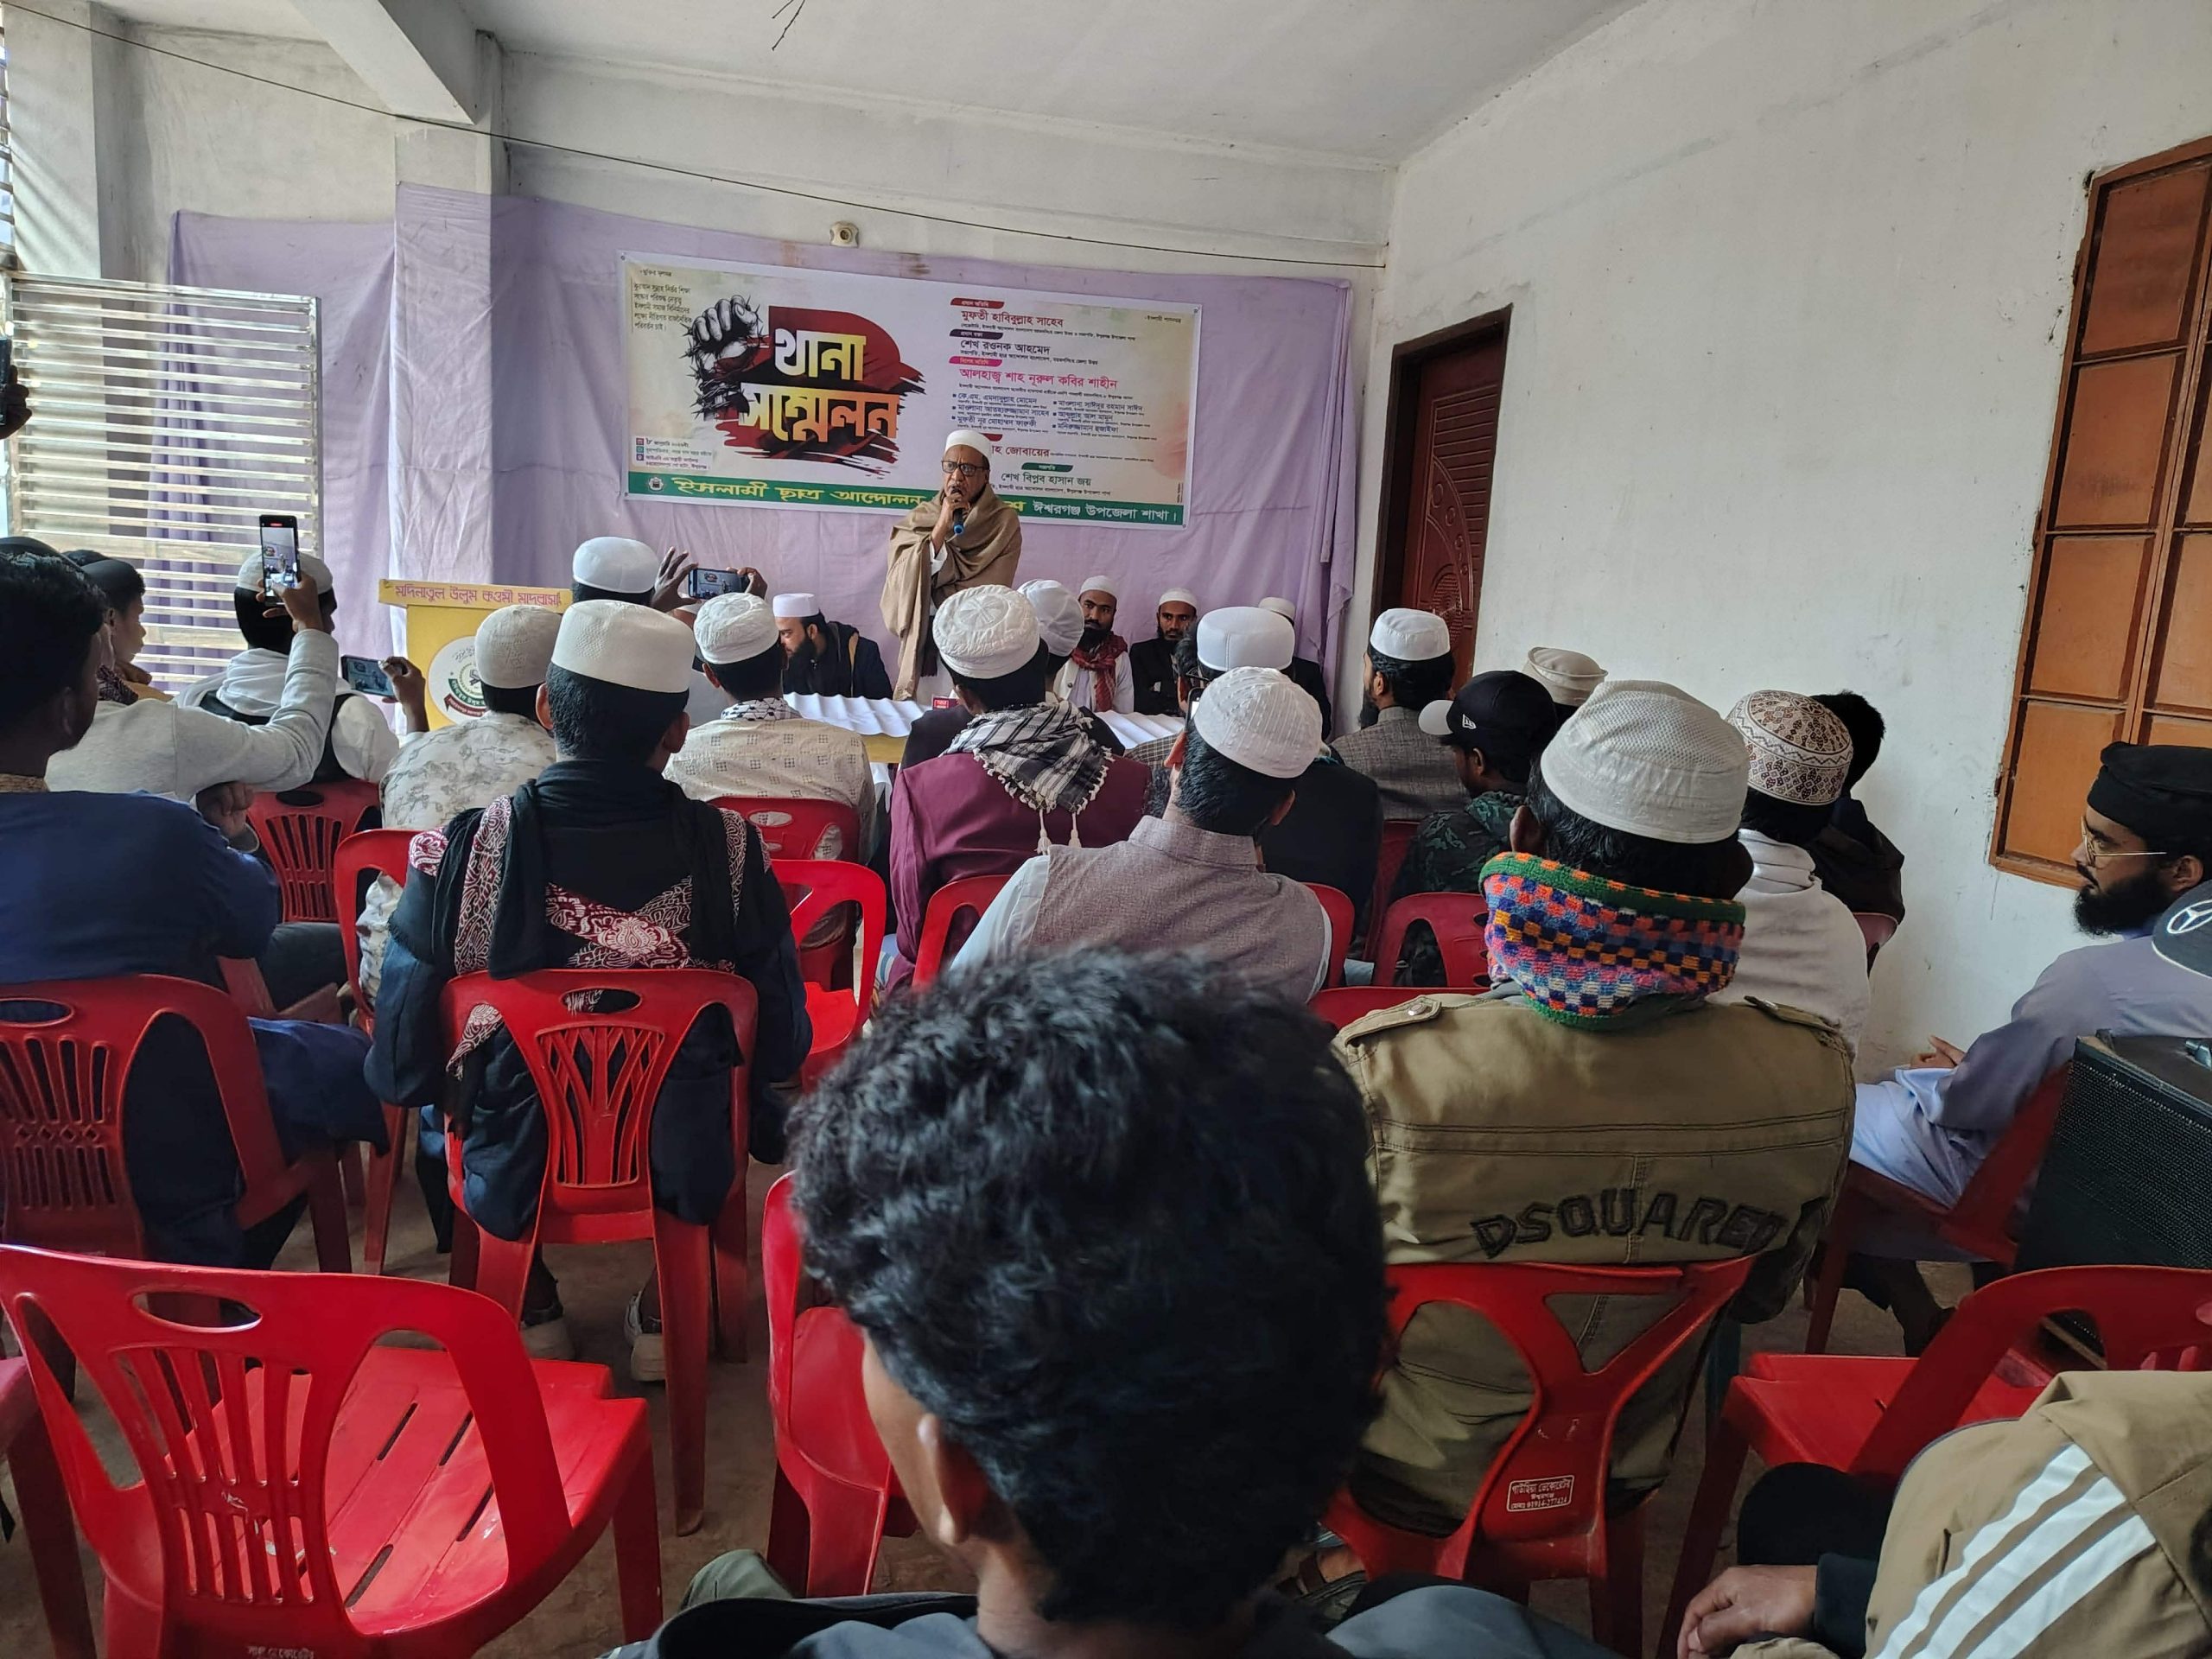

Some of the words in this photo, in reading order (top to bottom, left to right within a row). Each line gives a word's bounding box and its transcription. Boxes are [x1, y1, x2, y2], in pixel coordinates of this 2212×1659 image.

[961, 309, 988, 321] মুফতী
[991, 311, 1034, 325] হাবিবুল্লাহ
[1036, 316, 1064, 327] সাহেব
[774, 328, 867, 381] থানা
[961, 340, 980, 348] শেখ
[982, 341, 1013, 351] রওনক
[1014, 344, 1051, 355] আহমেদ
[959, 369, 1002, 384] আলহাজ্ব
[1005, 372, 1026, 382] শাহ
[1058, 374, 1084, 387] কবির
[1088, 376, 1119, 389] শাহীন
[738, 382, 900, 442] সম্মেলন
[1006, 447, 1050, 457] জোবায়ের
[1001, 473, 1020, 481] শেখ
[1022, 472, 1046, 484] বিপ্লব
[1048, 475, 1074, 486] হাসান
[671, 477, 771, 498] ইসলামী
[774, 486, 825, 503] ছাত্র
[829, 490, 926, 505] আন্দোলন
[1033, 500, 1081, 517] ঈশ্বরগঞ্জ
[1085, 503, 1138, 519] উপজেলা
[396, 584, 445, 604] মদিনাতুল
[449, 586, 477, 605] উলুম
[482, 589, 513, 603] কওমী
[1471, 1187, 1789, 1259] DSQUARED
